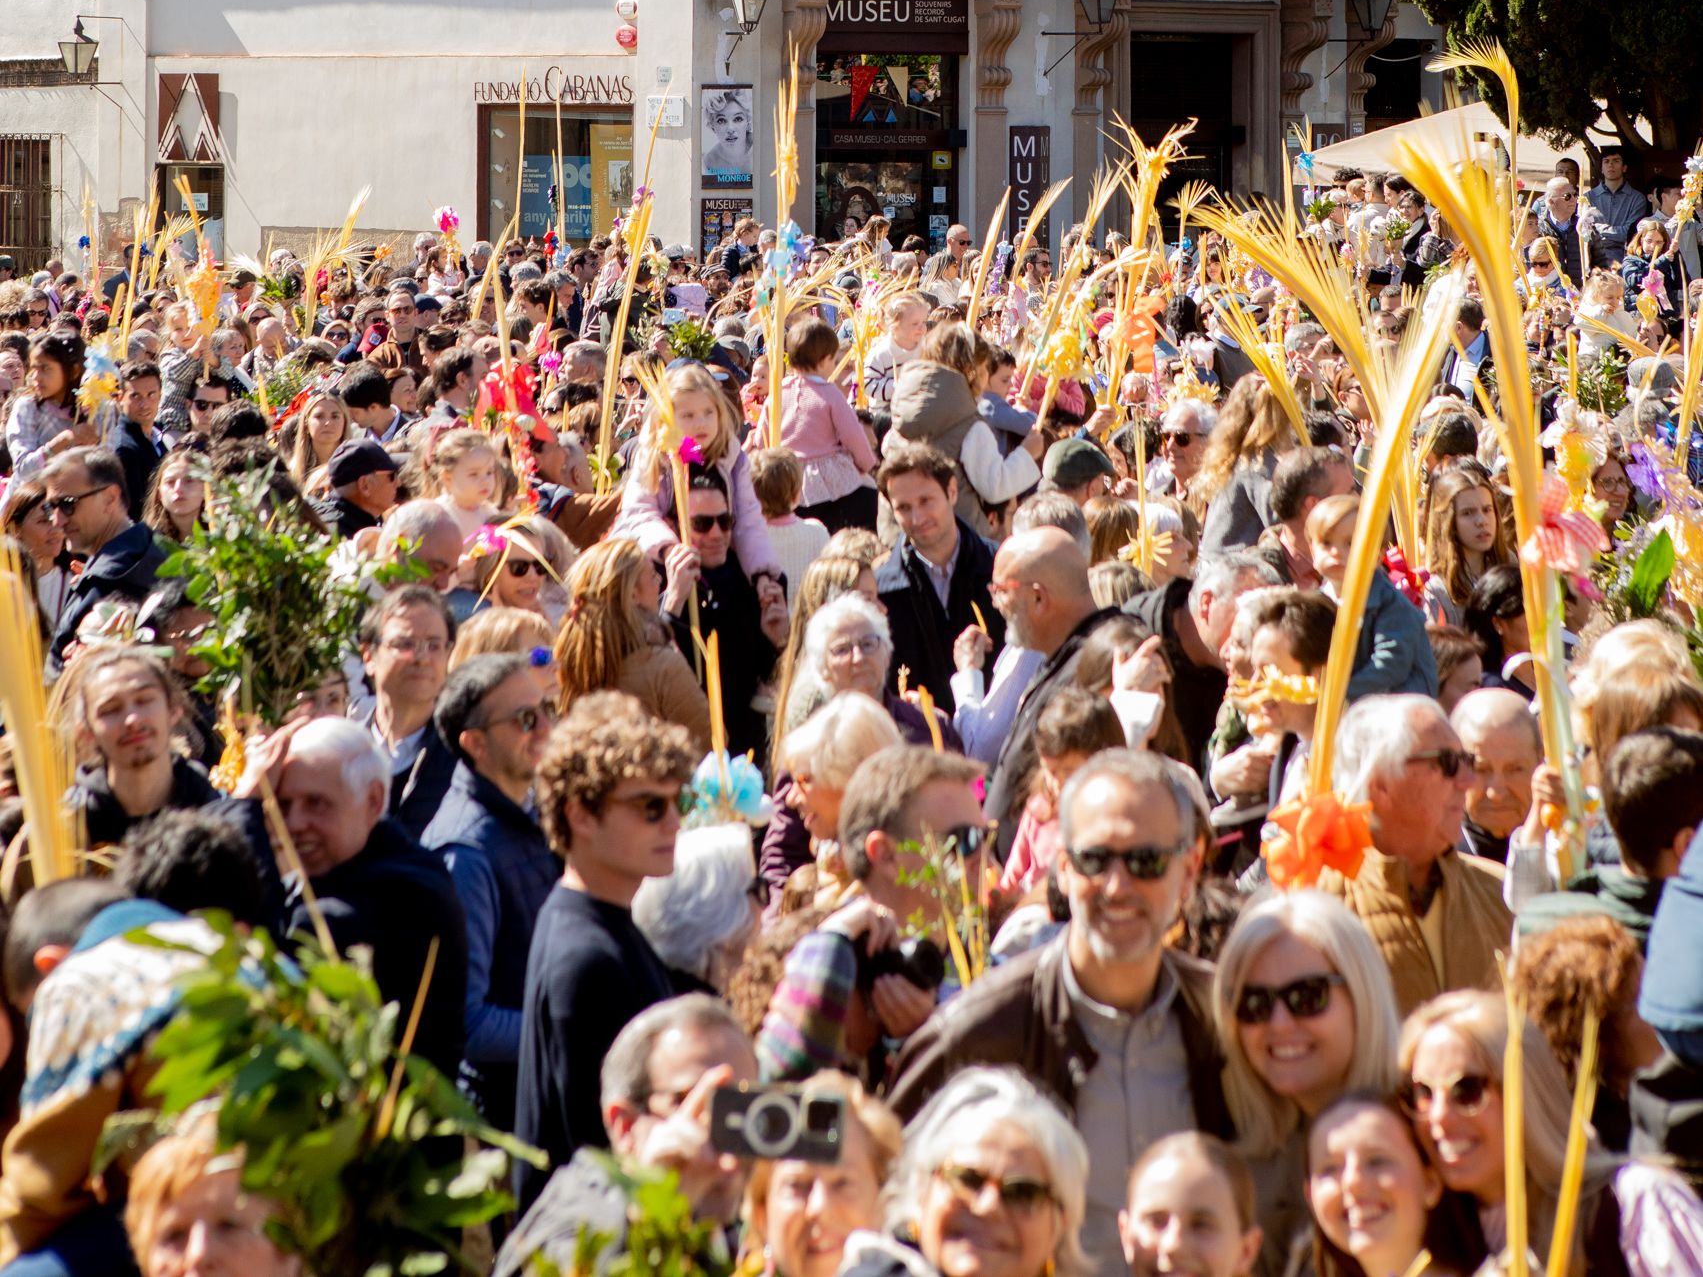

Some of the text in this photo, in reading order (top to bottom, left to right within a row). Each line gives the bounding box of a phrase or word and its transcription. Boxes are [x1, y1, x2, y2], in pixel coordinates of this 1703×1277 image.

[827, 0, 952, 23] MUSEU SOUVENIRS
[914, 8, 945, 16] RECORDS
[545, 66, 633, 102] CABANAS
[834, 135, 854, 143] CASA
[717, 174, 752, 182] MONROE
[886, 193, 917, 203] MUSEU
[705, 199, 735, 210] MUSEU
[524, 212, 547, 226] any
